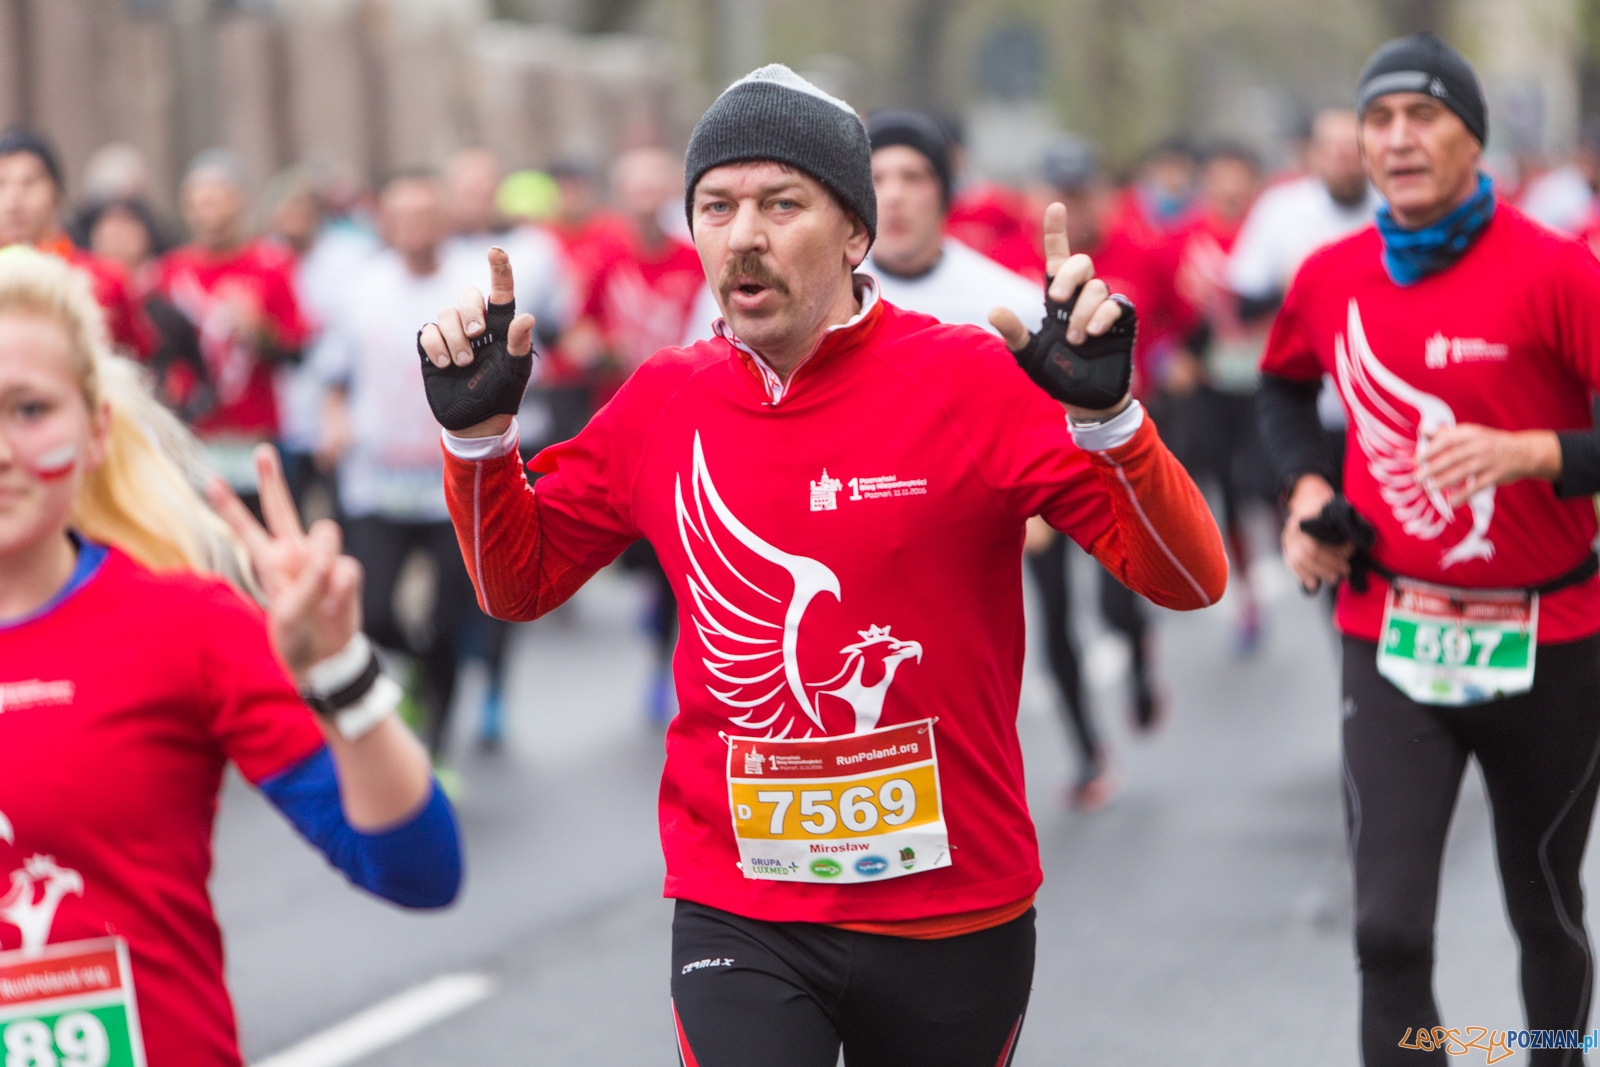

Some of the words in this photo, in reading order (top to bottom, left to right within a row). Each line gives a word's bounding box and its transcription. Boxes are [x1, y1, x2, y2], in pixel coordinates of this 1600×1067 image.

[847, 477, 863, 501] 1
[768, 754, 779, 771] 1
[836, 742, 919, 766] RunPoland.org
[736, 804, 752, 820] D
[757, 778, 917, 835] 7569
[809, 843, 870, 853] Mirosław
[751, 858, 782, 867] GRUPA
[752, 866, 789, 875] LUXMED
